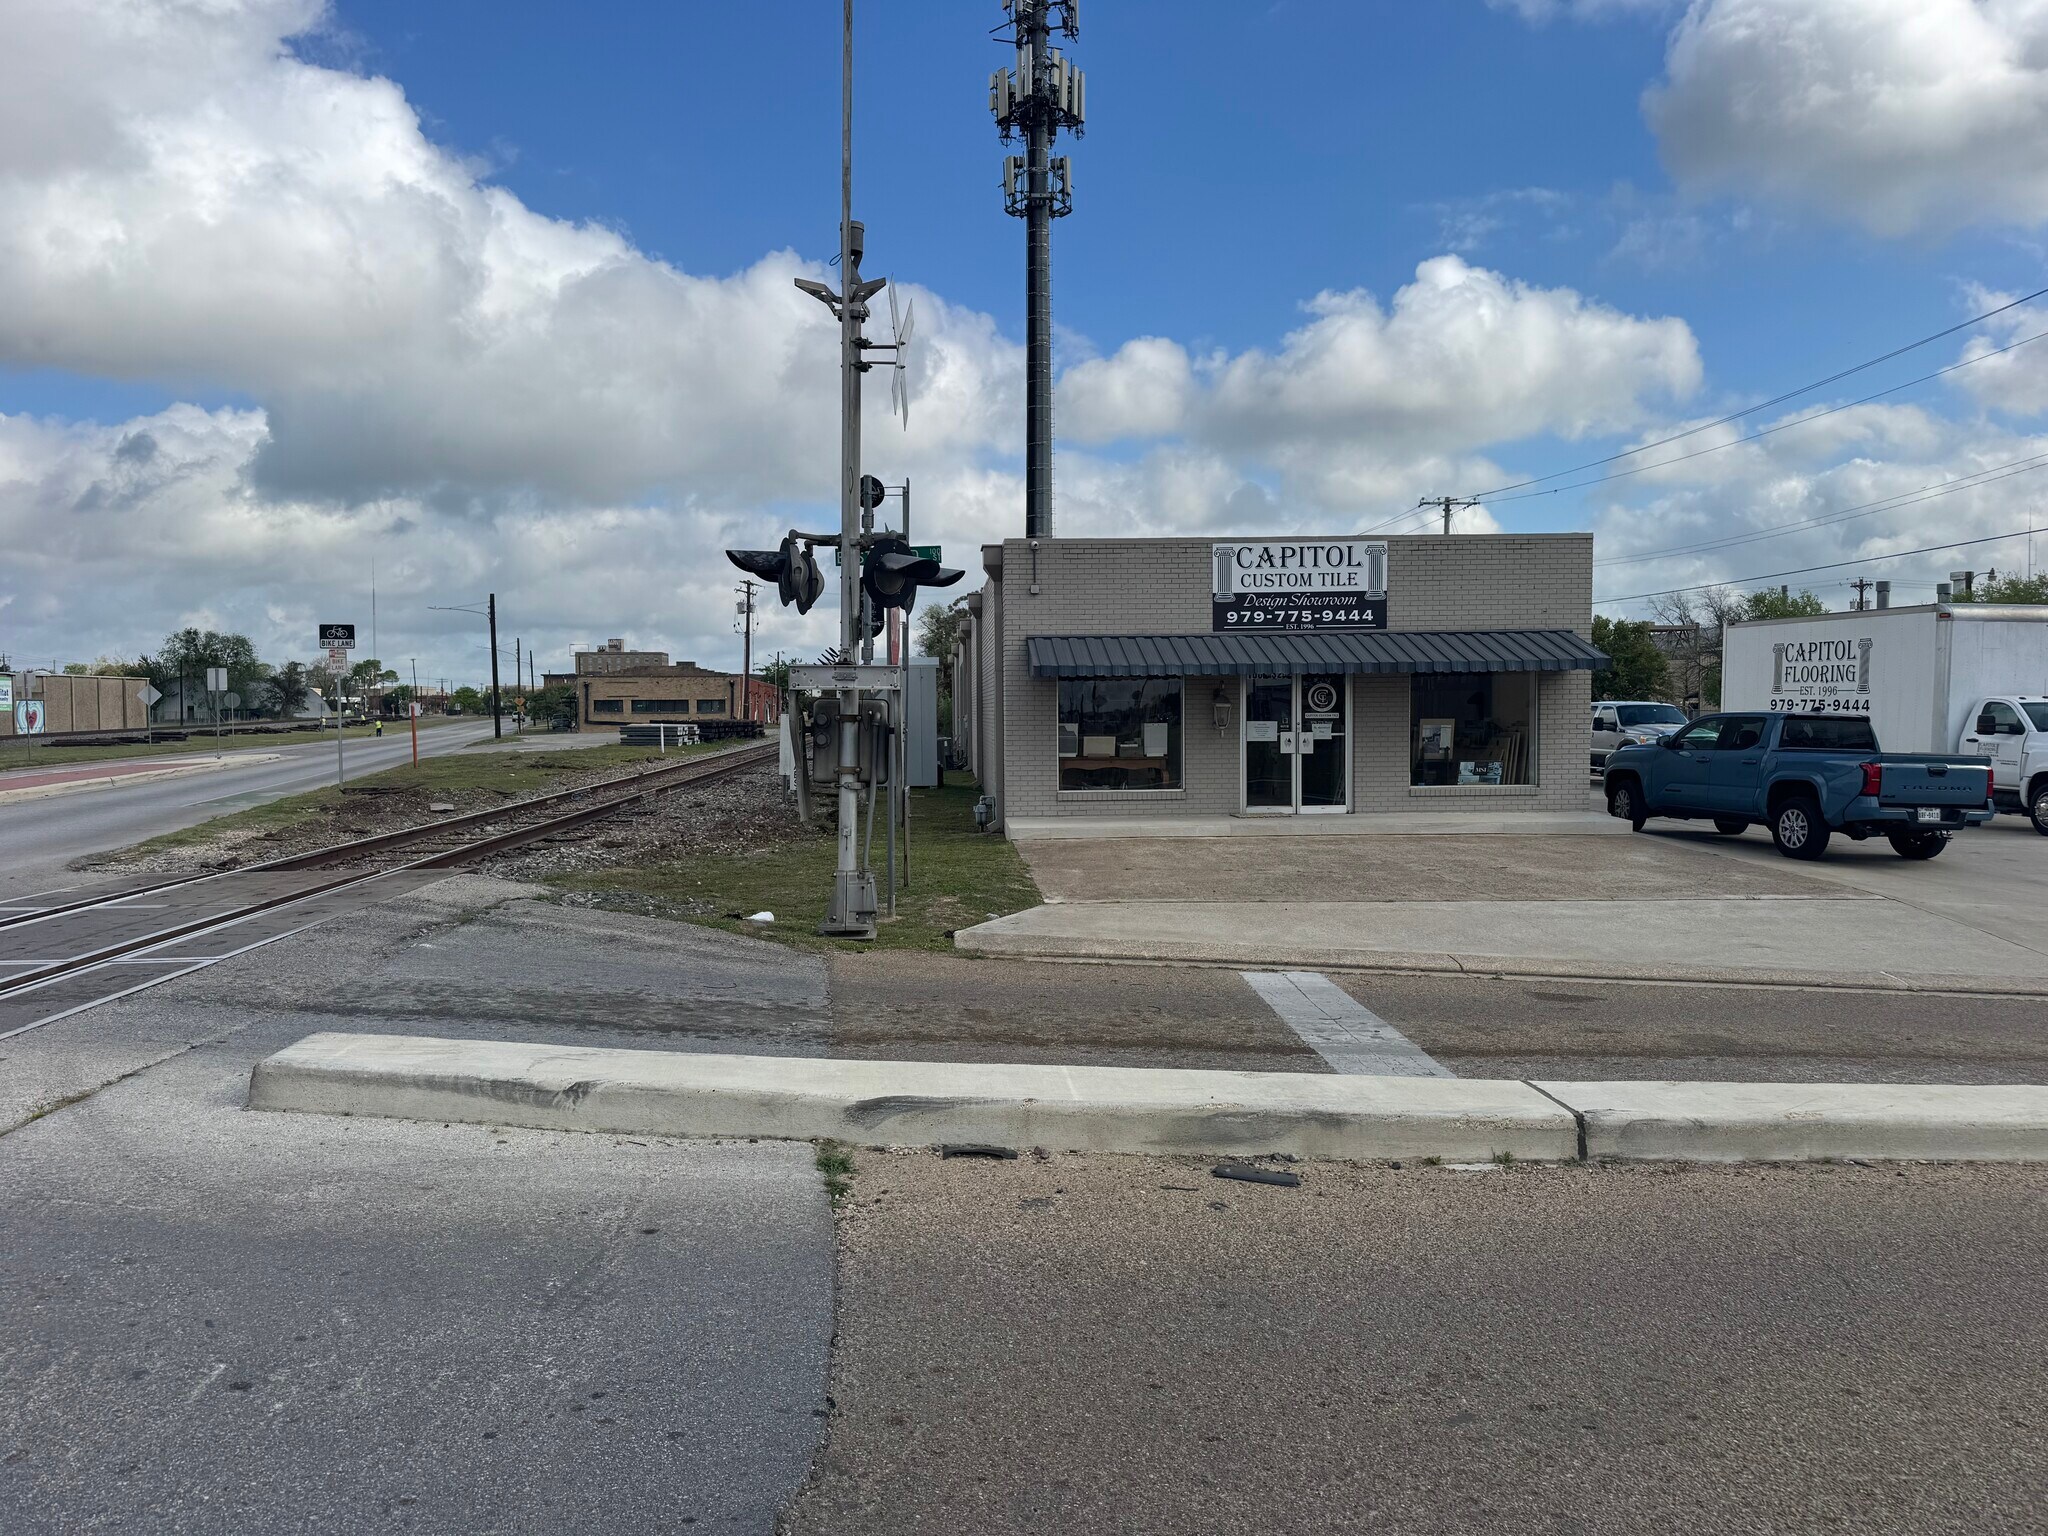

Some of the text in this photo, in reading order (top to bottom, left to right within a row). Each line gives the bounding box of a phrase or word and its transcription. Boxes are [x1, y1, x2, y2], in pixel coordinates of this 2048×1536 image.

[1236, 546, 1363, 569] CAPITOL
[1240, 572, 1358, 588] CUSTOM TILE
[1243, 593, 1357, 610] Design Showroom
[1226, 609, 1374, 623] 979-775-9444
[1784, 640, 1856, 662] CAPITOL
[1784, 664, 1857, 683] FLOORING
[1800, 685, 1838, 697] EST. 1996
[1770, 699, 1870, 711] 979-775-9444
